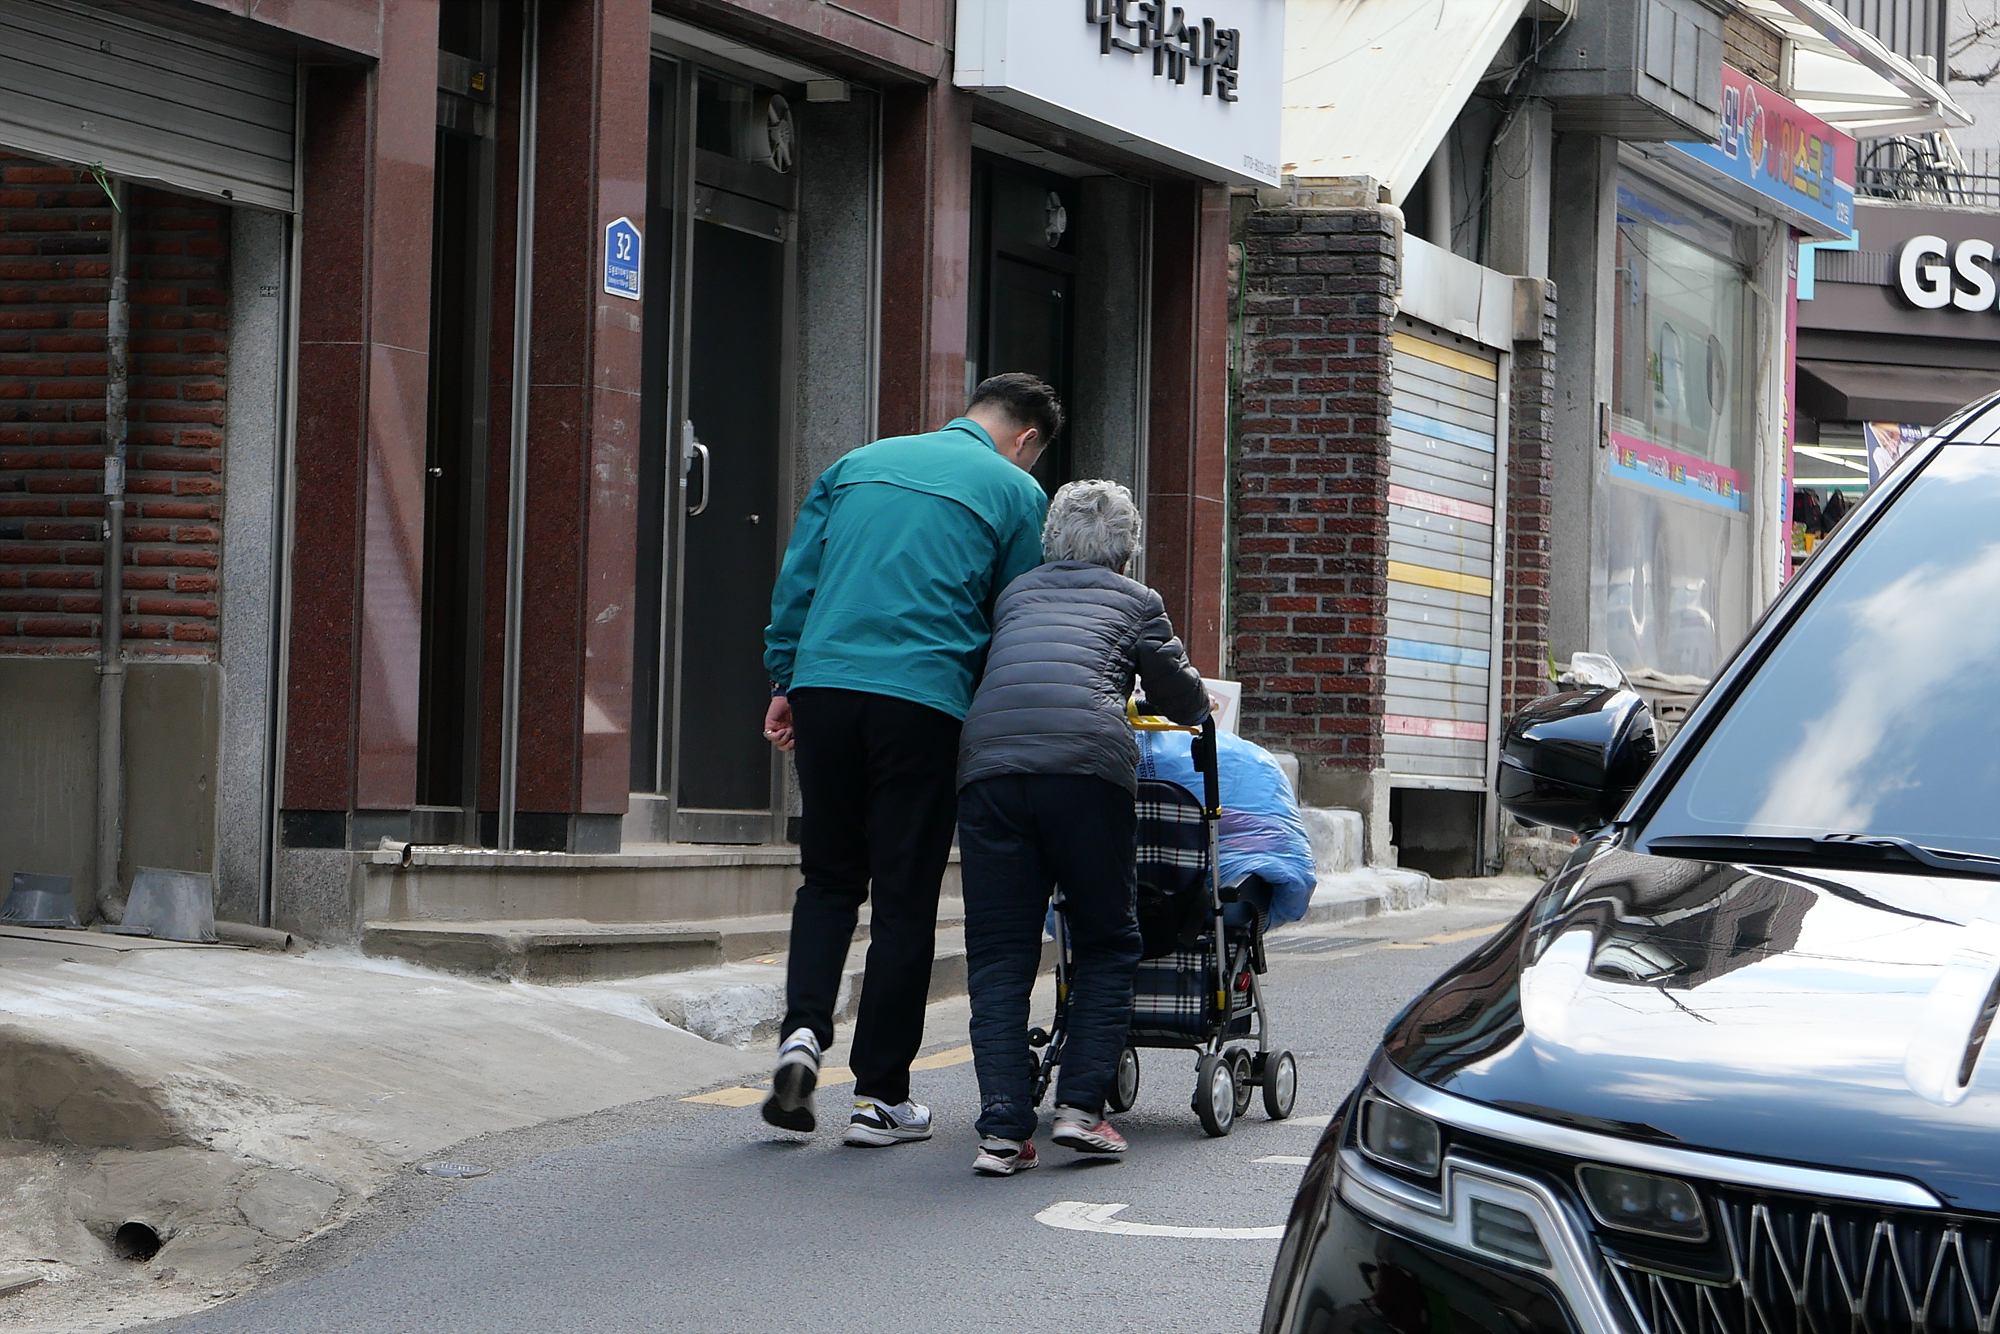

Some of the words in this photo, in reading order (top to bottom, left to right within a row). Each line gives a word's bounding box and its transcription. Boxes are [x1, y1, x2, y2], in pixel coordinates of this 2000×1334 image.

[1766, 110, 1835, 210] 아이스크림
[616, 232, 632, 261] 32
[1900, 235, 2000, 311] GS
